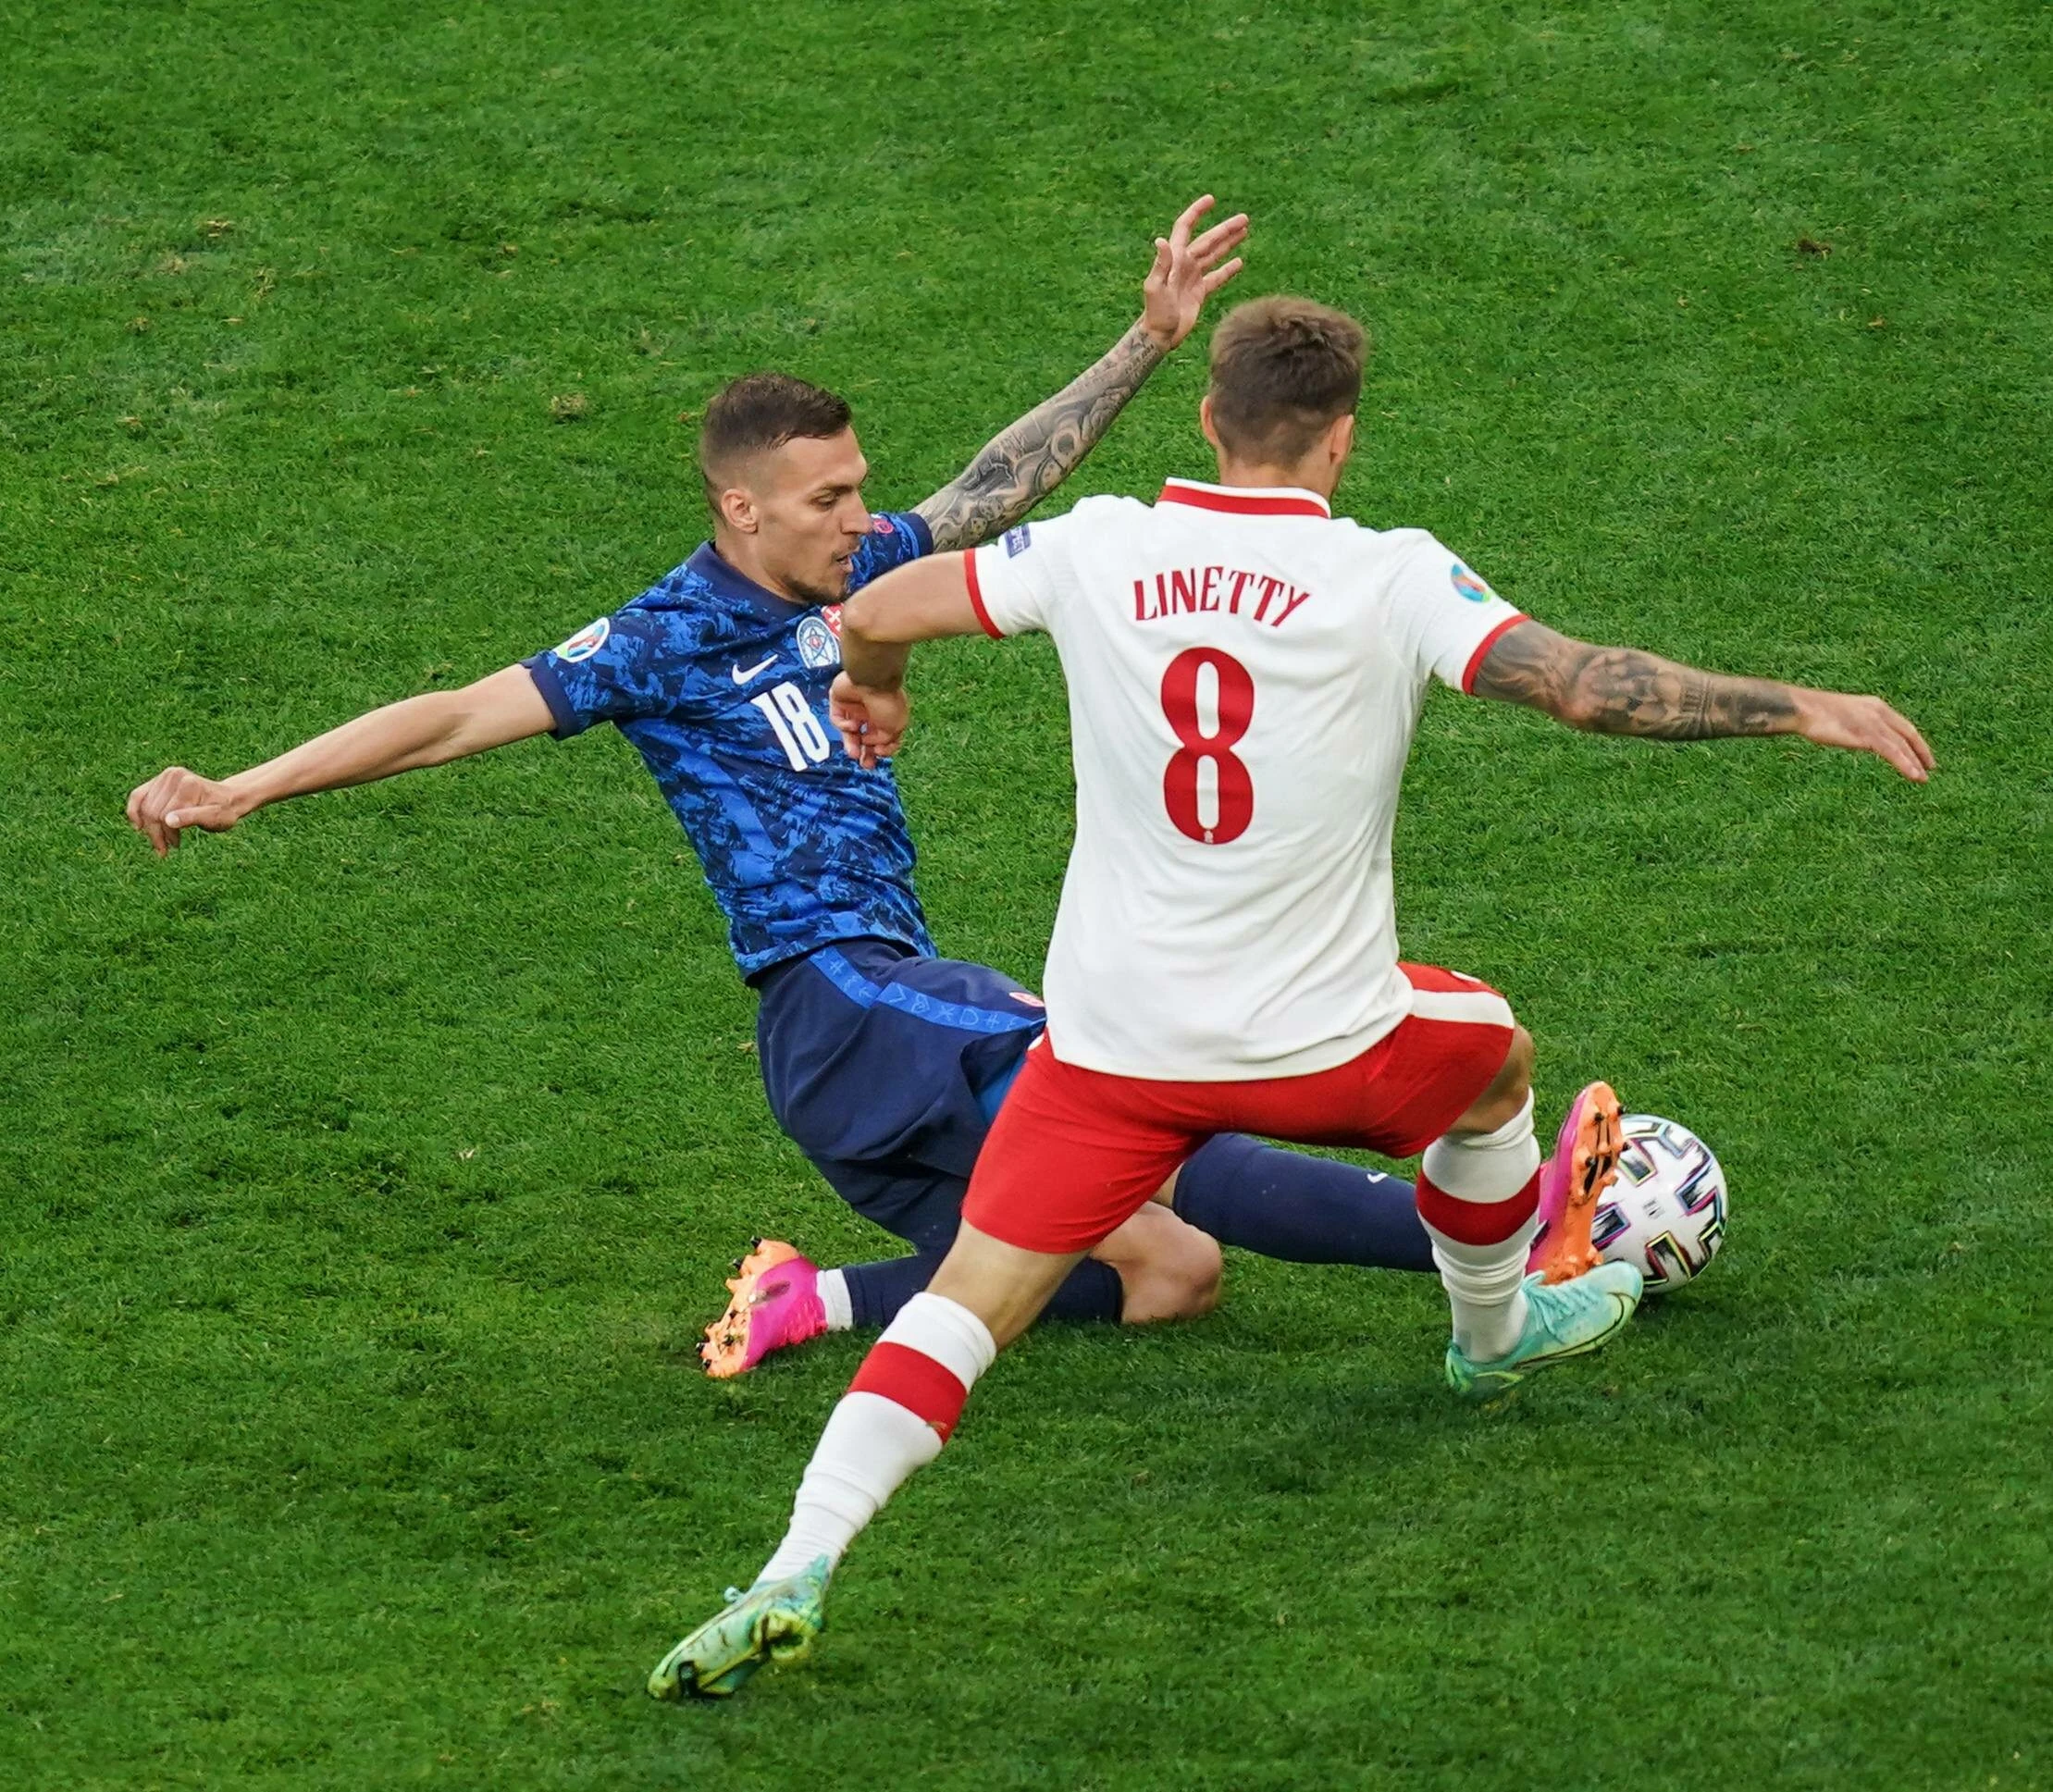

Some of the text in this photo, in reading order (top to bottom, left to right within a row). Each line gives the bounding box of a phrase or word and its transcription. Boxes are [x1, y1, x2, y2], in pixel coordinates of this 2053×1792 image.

[1133, 566, 1310, 627] LINETTY
[750, 681, 830, 772] 18
[1160, 646, 1255, 846] 8
